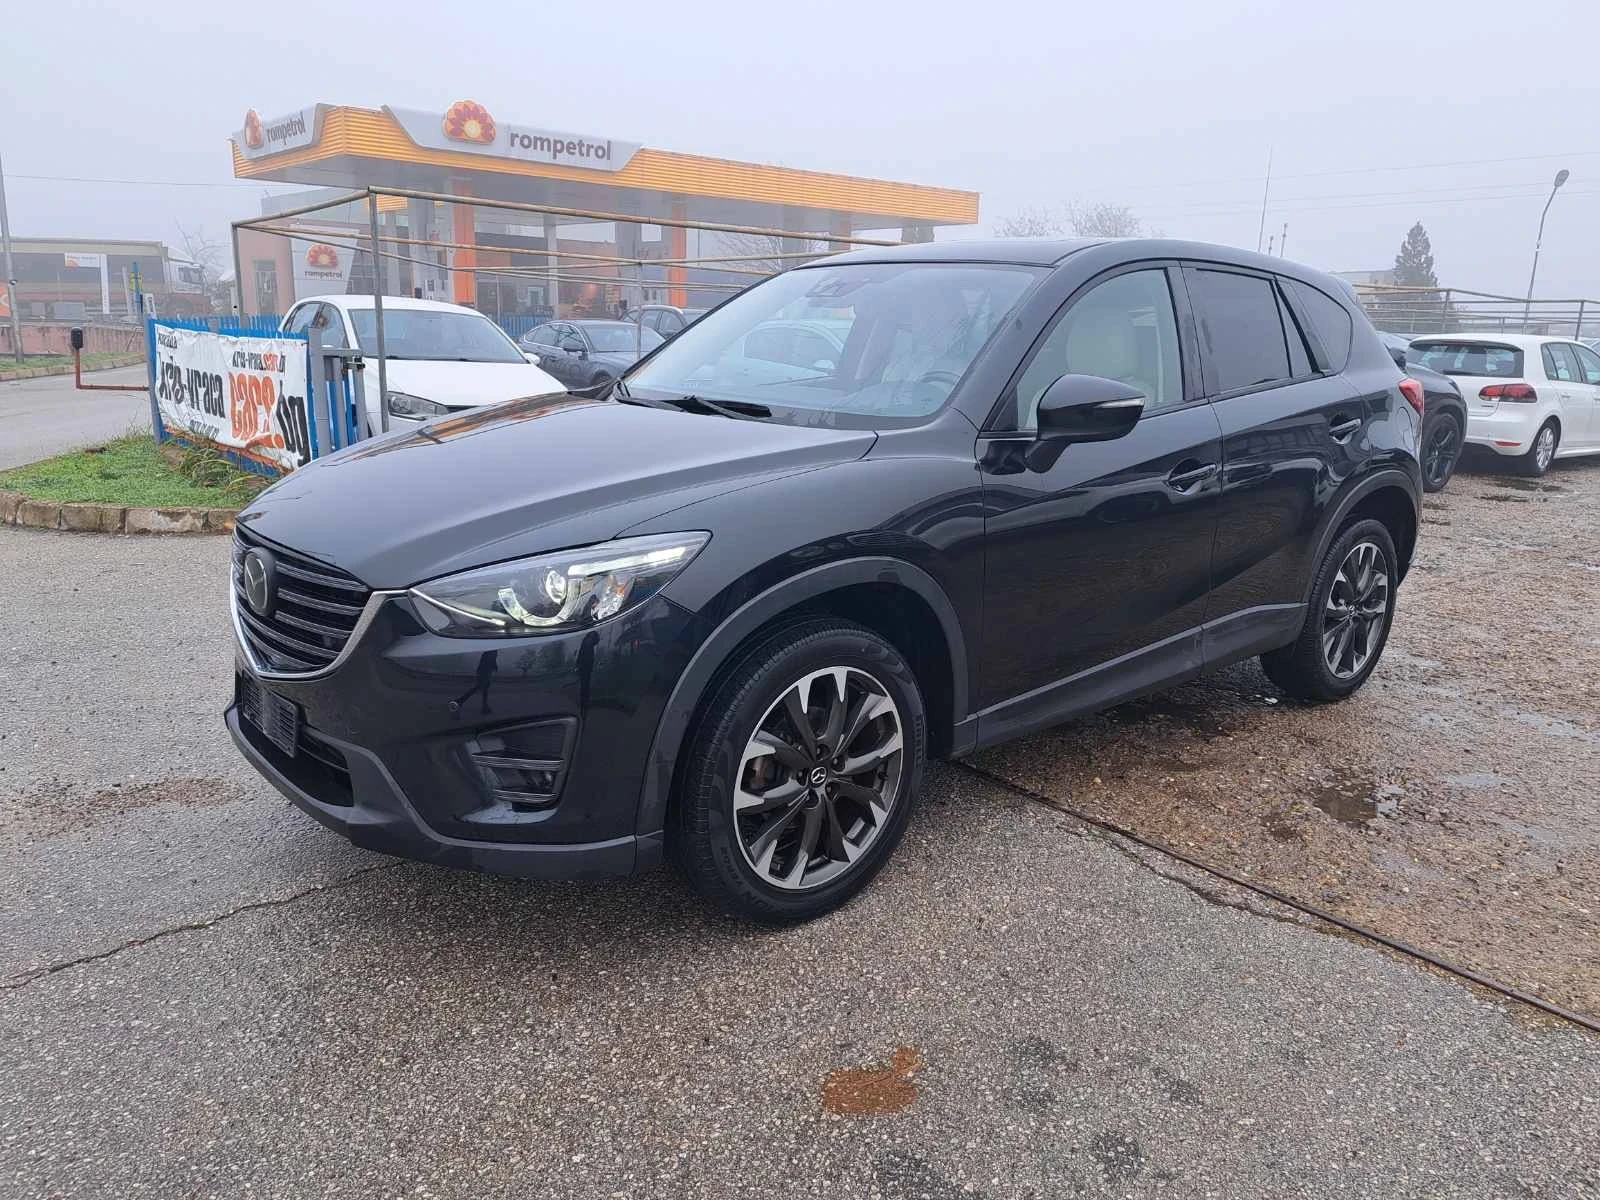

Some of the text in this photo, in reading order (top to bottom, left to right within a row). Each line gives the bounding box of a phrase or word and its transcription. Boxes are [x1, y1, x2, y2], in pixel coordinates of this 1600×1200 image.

[266, 109, 306, 146] rompetrol
[510, 131, 612, 161] rompetrol
[304, 270, 343, 281] rompetrol
